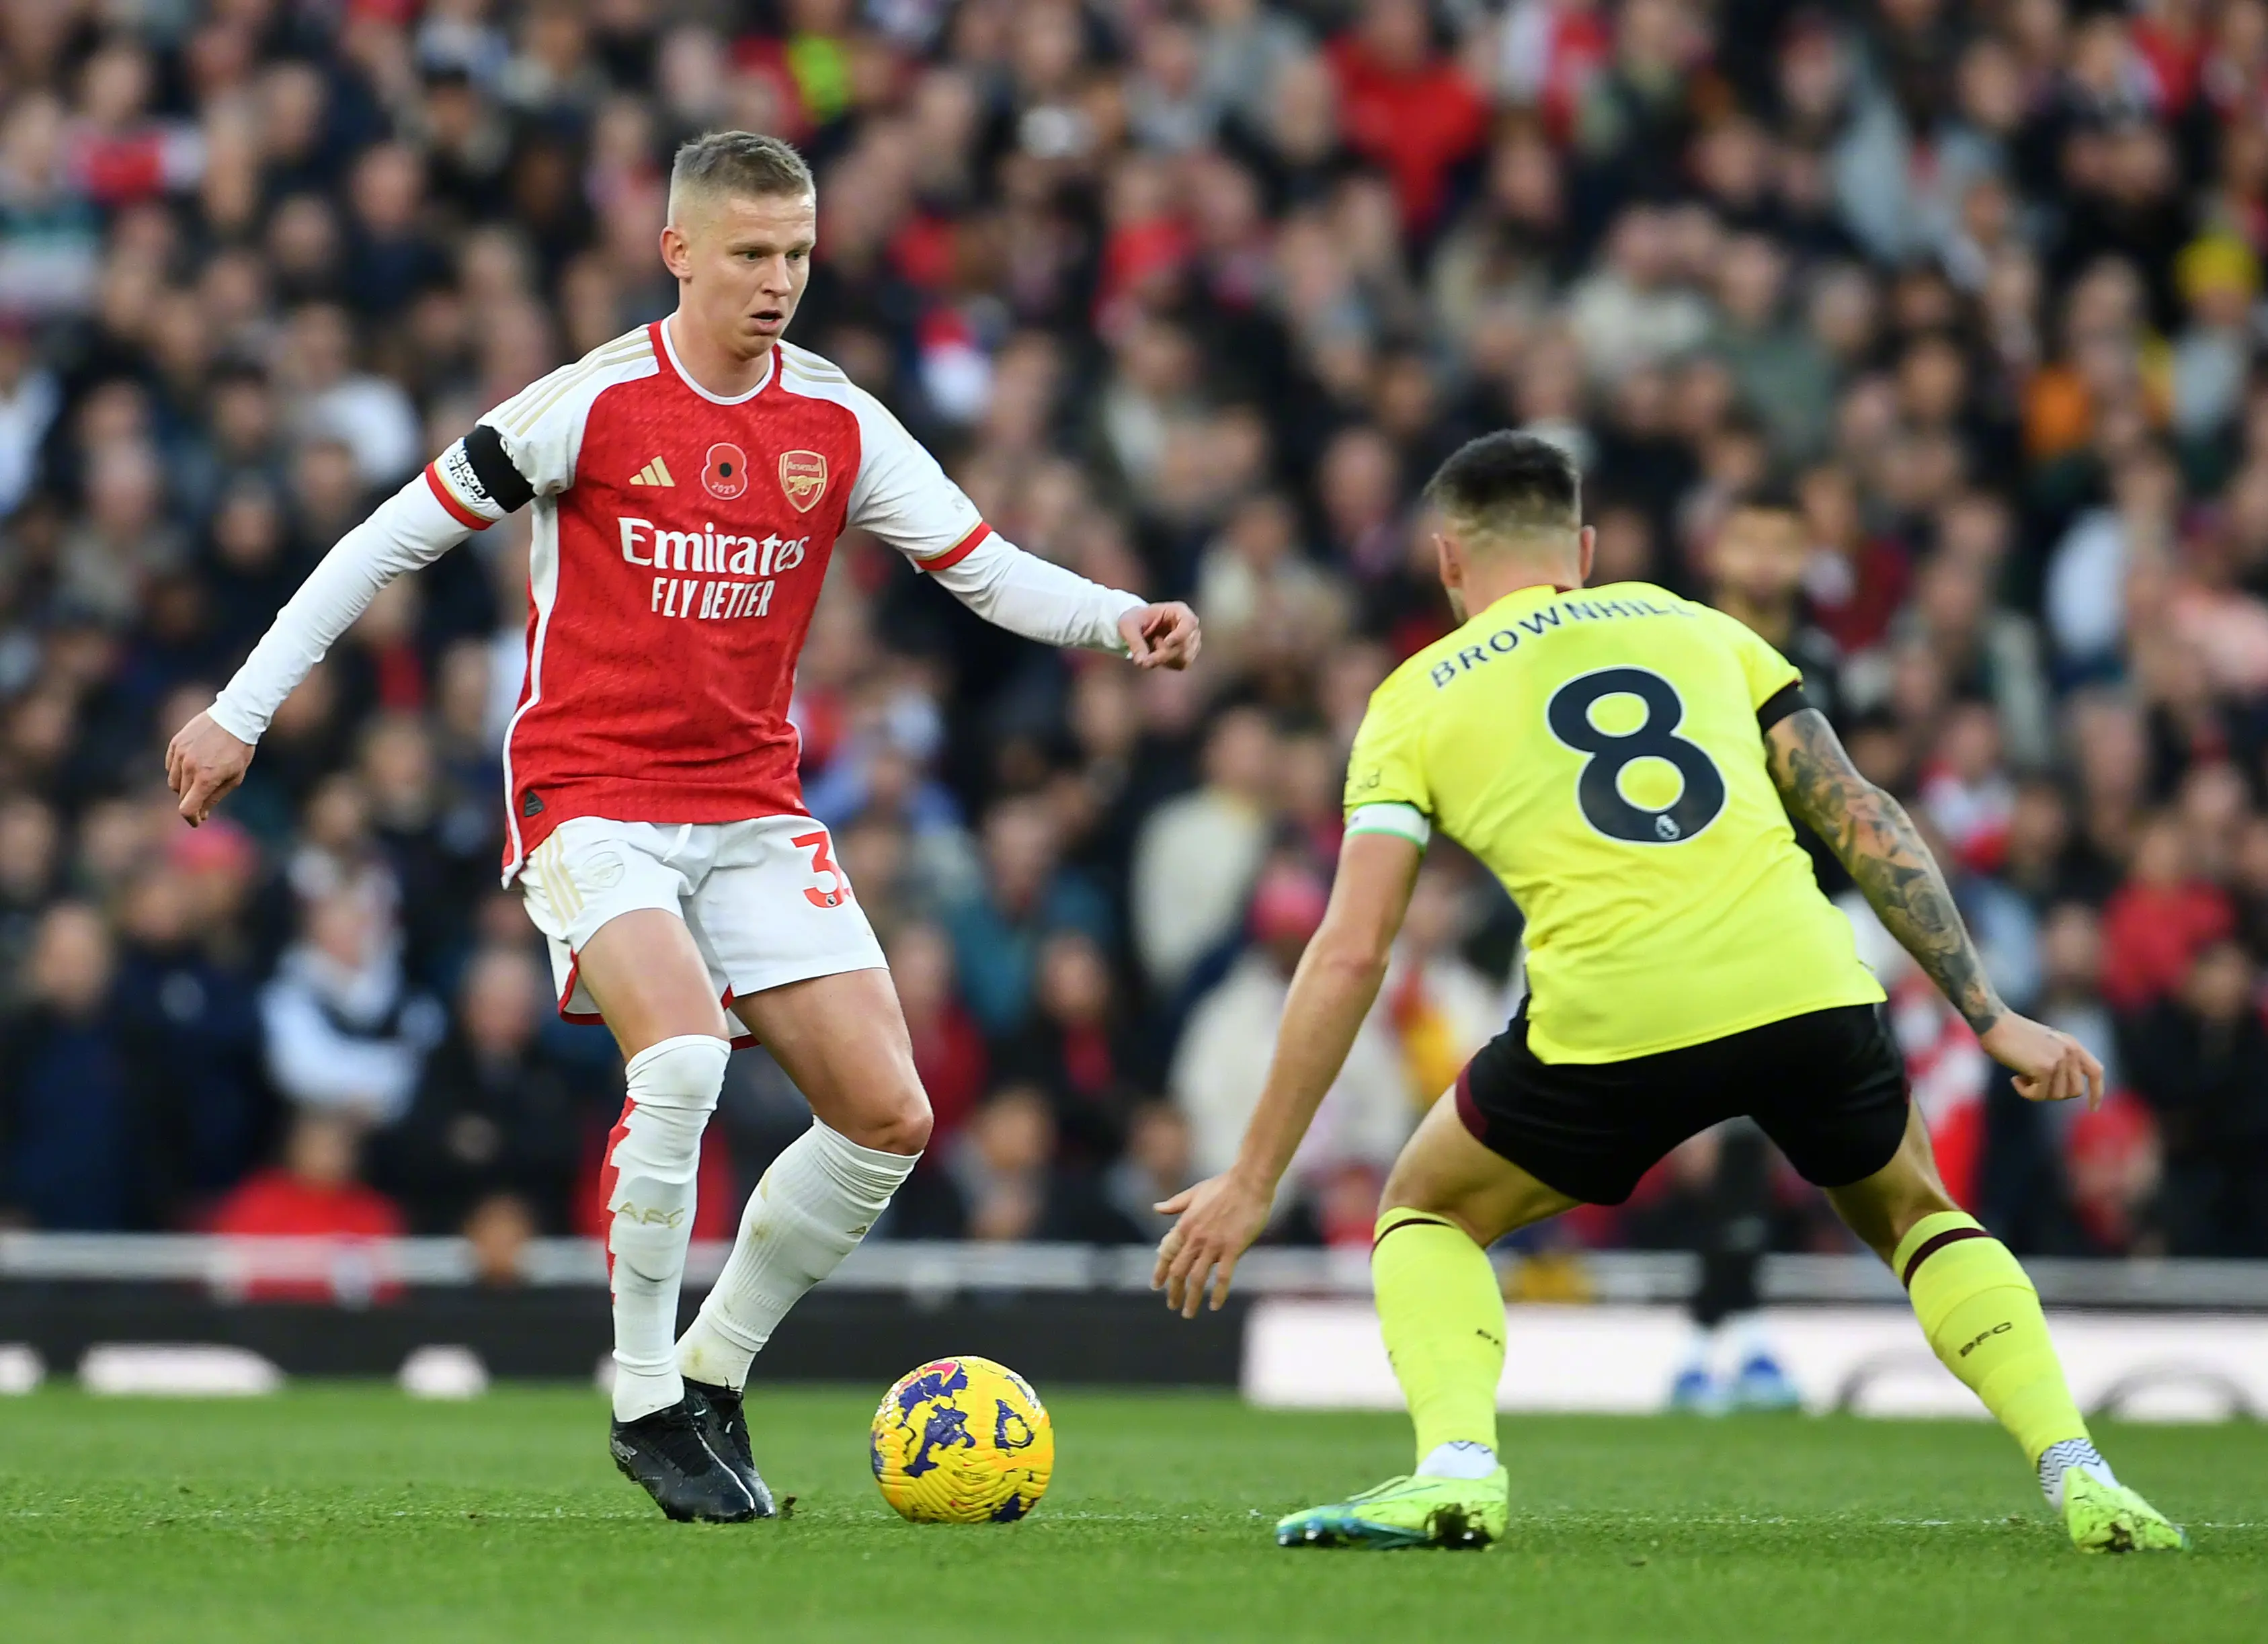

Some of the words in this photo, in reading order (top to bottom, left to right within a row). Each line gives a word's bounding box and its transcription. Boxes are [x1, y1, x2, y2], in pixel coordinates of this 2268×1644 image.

[460, 462, 486, 496] room
[711, 481, 737, 495] 2023
[617, 517, 810, 576] Emirates
[651, 577, 698, 618] FLY
[698, 580, 775, 620] BETTER
[1430, 600, 1695, 689] BROWNHILL
[1546, 666, 1726, 844] 8
[790, 831, 852, 908] 3
[617, 1201, 685, 1229] AFC
